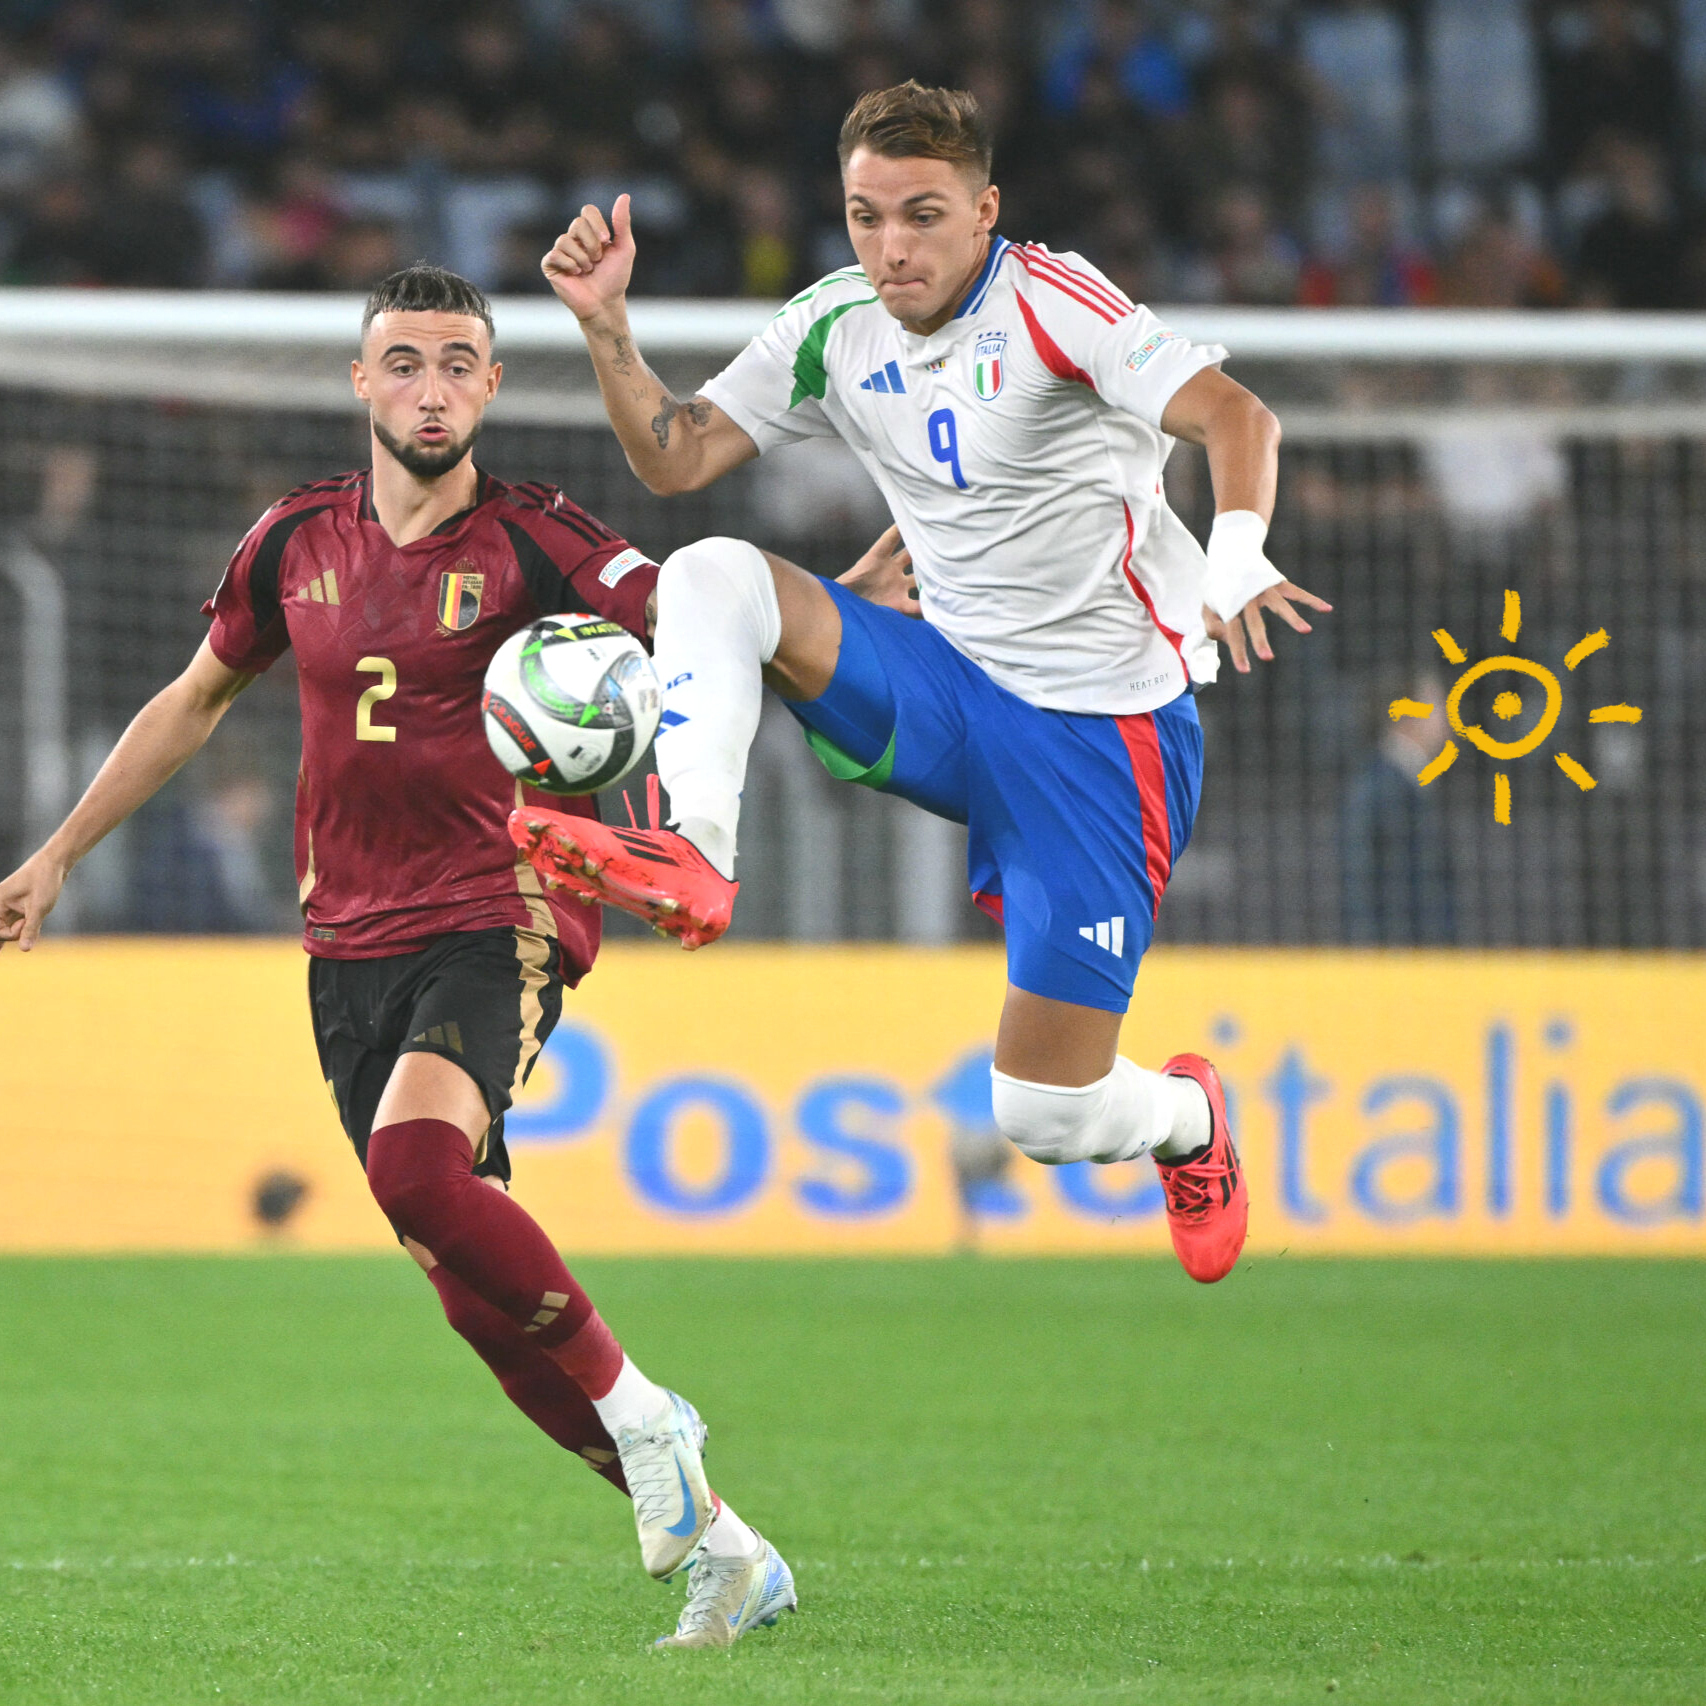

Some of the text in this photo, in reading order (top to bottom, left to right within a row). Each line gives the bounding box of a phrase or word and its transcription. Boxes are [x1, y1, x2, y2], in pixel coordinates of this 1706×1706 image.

[977, 343, 1000, 357] ITALIA
[927, 408, 968, 489] 9
[356, 656, 397, 742] 2
[492, 700, 537, 752] LEAGUE
